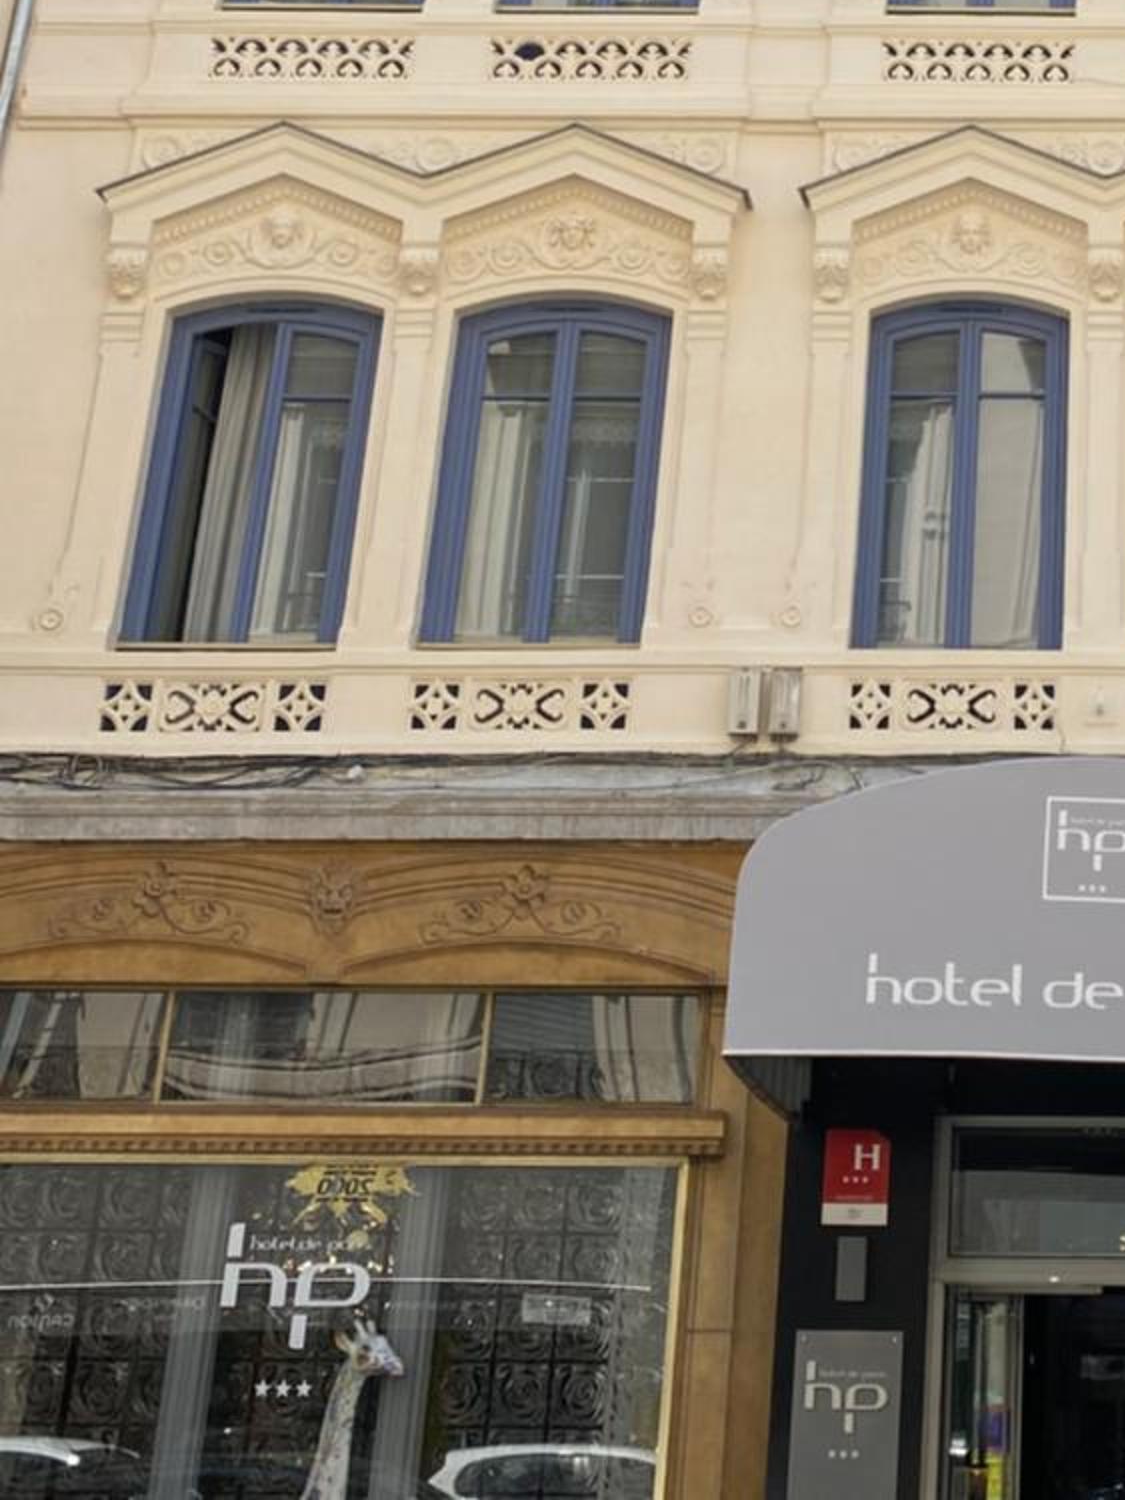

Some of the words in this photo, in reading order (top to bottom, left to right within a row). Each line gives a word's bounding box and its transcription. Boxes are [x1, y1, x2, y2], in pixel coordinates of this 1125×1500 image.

[866, 952, 1023, 1007] hotel
[1042, 971, 1125, 1010] de
[854, 1143, 881, 1171] H
[220, 1222, 371, 1350] hp
[804, 1360, 888, 1434] hp
